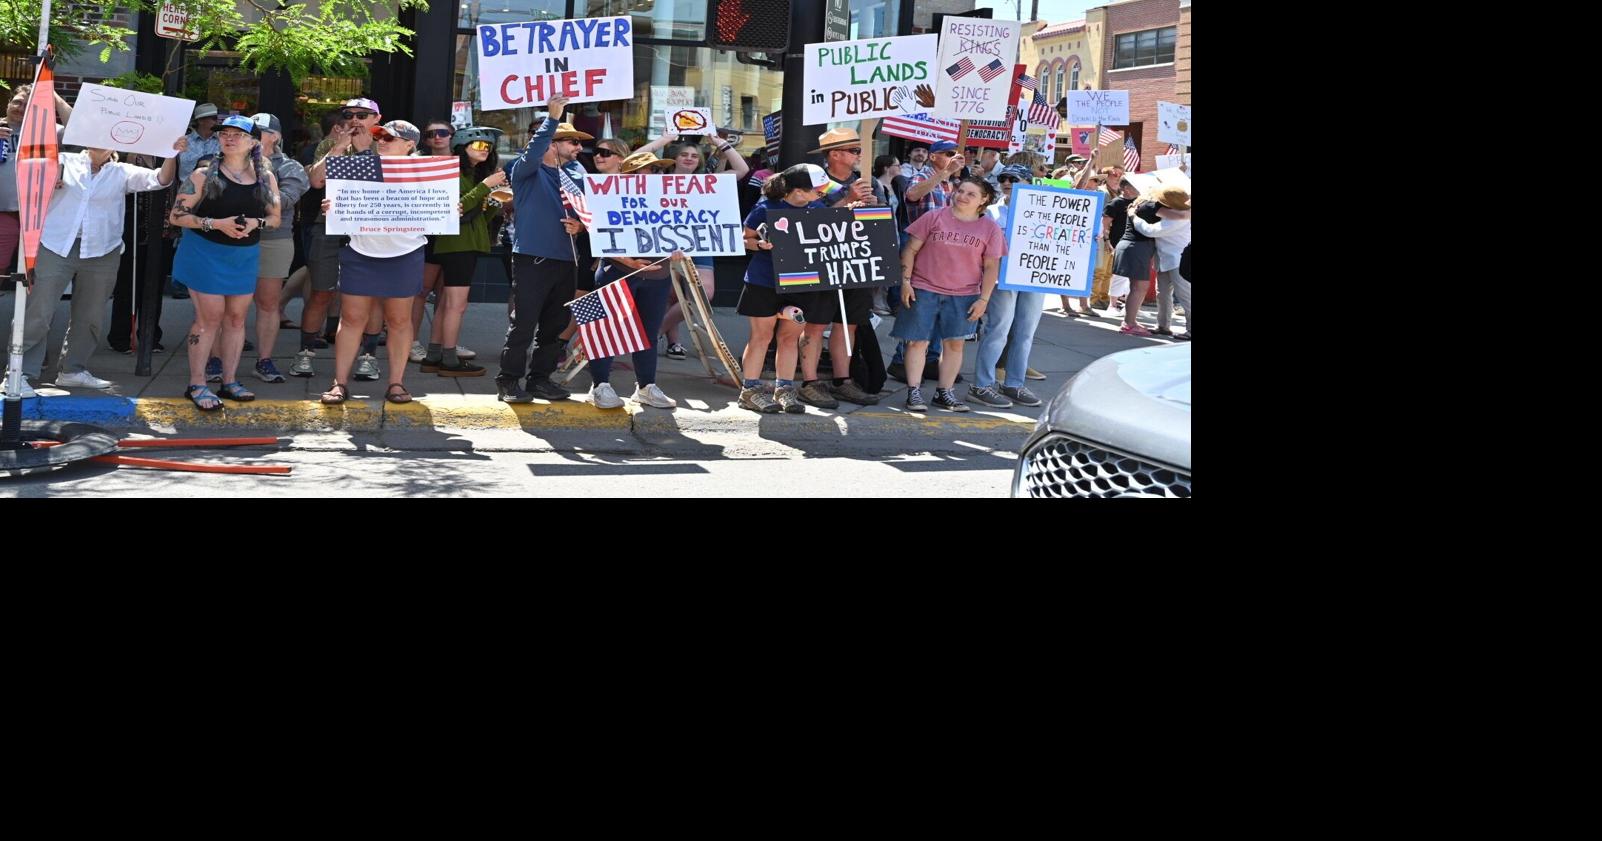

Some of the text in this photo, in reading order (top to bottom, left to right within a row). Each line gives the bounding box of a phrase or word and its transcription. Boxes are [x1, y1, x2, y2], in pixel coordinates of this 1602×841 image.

[480, 18, 630, 57] BETRAYER
[950, 23, 1010, 39] RESISTING
[818, 42, 892, 67] PUBLIC
[960, 39, 1001, 56] KINGS
[545, 57, 569, 73] IN
[850, 61, 928, 85] LANDS
[500, 69, 607, 104] CHIEF
[952, 86, 991, 101] SINCE
[811, 86, 899, 118] in PUBLIC
[1075, 100, 1123, 108] THE PEOPLE
[1086, 91, 1110, 101] WE
[954, 101, 985, 113] 1776
[587, 174, 718, 195] WITH FEAR
[622, 197, 688, 209] FOR OUR
[1029, 194, 1091, 212] THE POWER
[607, 209, 720, 225] DEMOCRACY
[1024, 210, 1088, 227] OF THE PEOPLE
[597, 224, 740, 254] I DISSENT
[1017, 224, 1086, 244] IS GREATER
[804, 241, 872, 264] TRUMPS
[1029, 241, 1071, 256] THAN THE
[1020, 252, 1076, 271] PEOPLE IN
[826, 257, 885, 285] HATE
[1031, 271, 1071, 287] POWER
